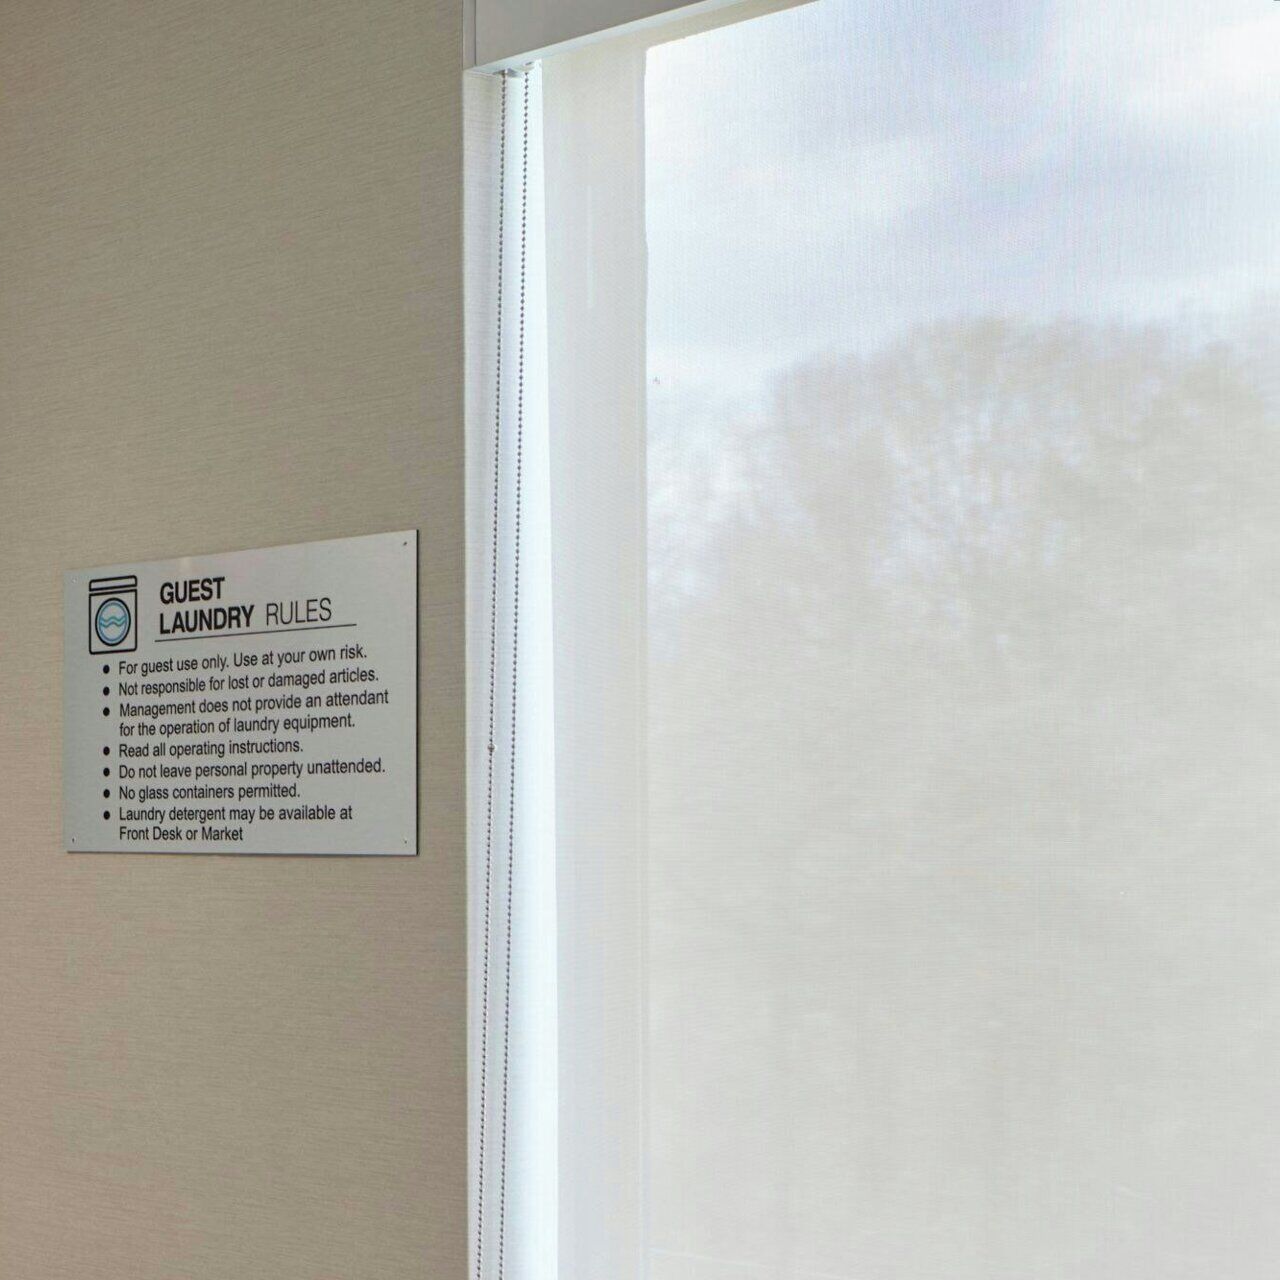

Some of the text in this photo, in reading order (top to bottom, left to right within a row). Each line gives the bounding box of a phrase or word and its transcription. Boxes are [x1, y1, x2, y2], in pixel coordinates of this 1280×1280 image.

[160, 576, 225, 604] GUEST
[160, 597, 332, 634] LAUNDRY RULES
[119, 644, 367, 677] For guest use only. Use at your own risk.
[119, 667, 379, 697] Not responsible for lost or damaged articles.
[120, 689, 389, 719] Management does not provide an attendant
[120, 713, 355, 738] for the operation of laundry equipment.
[119, 739, 303, 759] Read all operating instructions.
[119, 757, 385, 780] Do not leave personal property unattended.
[119, 783, 300, 803] No glass containers permitted.
[119, 805, 352, 824] Laundry detergent may be available at
[119, 826, 243, 840] Front Desk or Market
